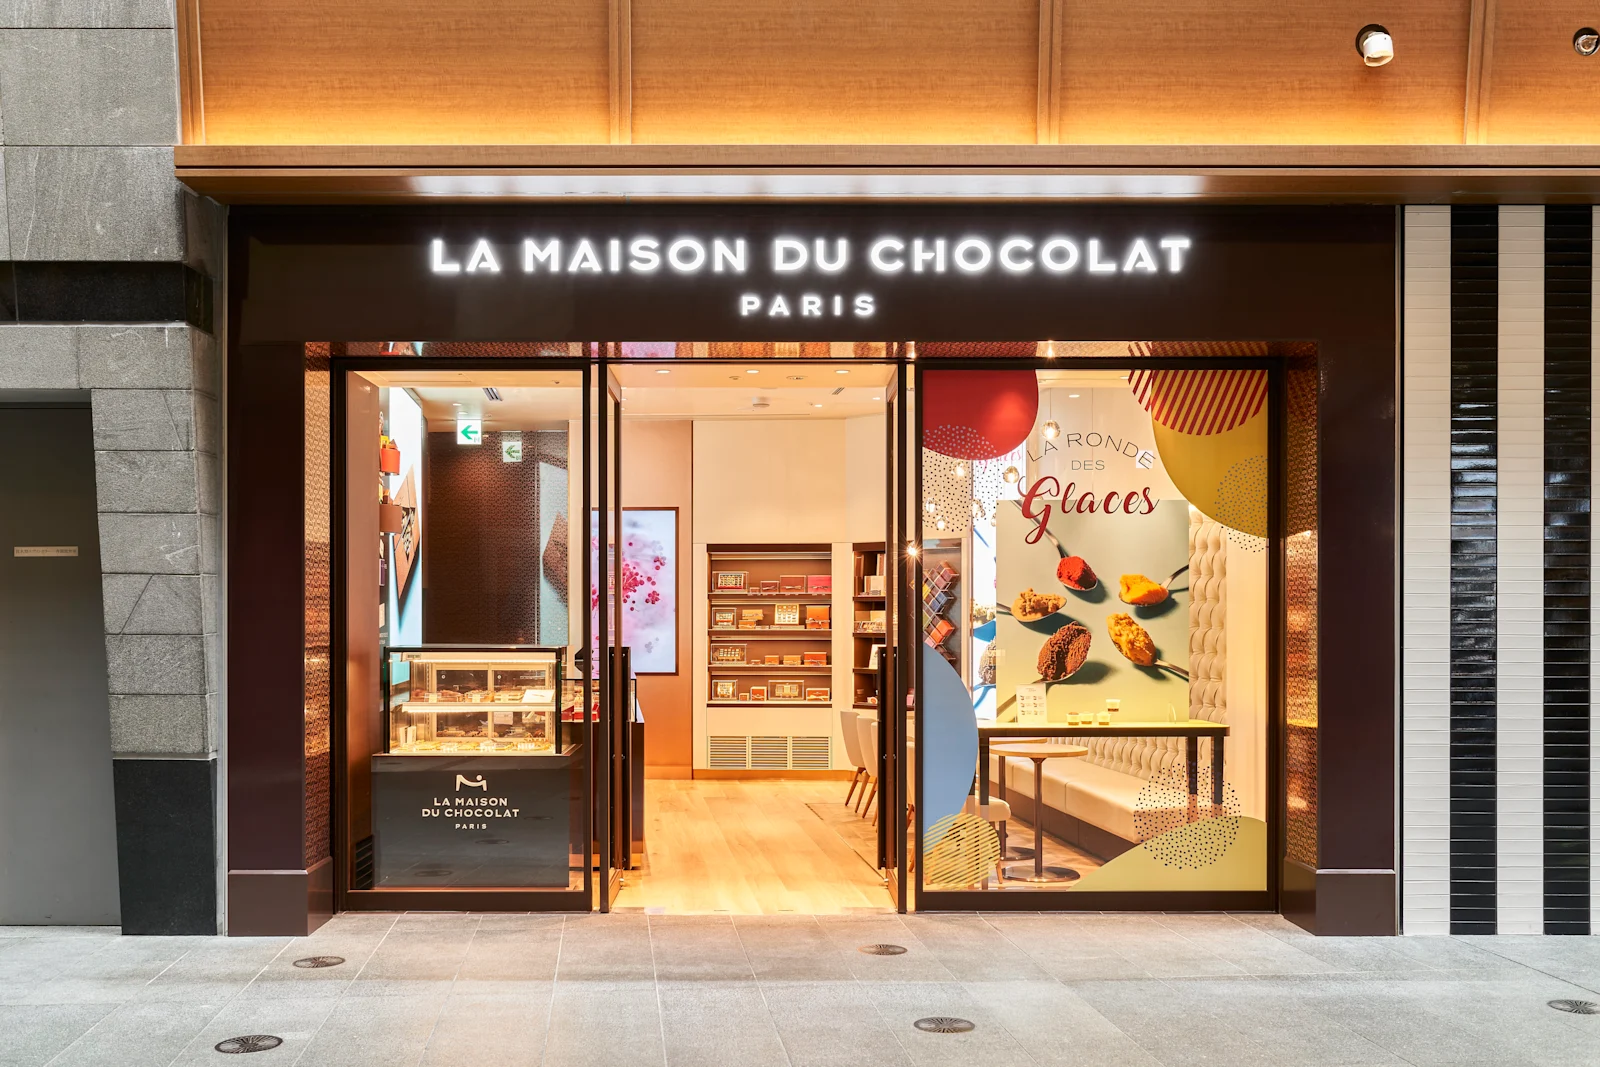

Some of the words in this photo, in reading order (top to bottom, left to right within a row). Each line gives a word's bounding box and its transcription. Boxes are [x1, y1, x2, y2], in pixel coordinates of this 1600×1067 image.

[431, 238, 502, 274] LA
[523, 238, 747, 274] MAISON
[774, 238, 848, 274] DU
[869, 238, 1191, 274] CHOCOLAT
[740, 294, 876, 318] PARIS
[1026, 440, 1058, 463] LA
[1066, 432, 1157, 470] RONDE
[1071, 459, 1105, 471] DES
[1017, 475, 1160, 545] Glaces
[421, 808, 440, 818] DU
[444, 808, 520, 818] CHOCOLAT
[433, 797, 451, 807] LA
[455, 797, 508, 807] MAISON
